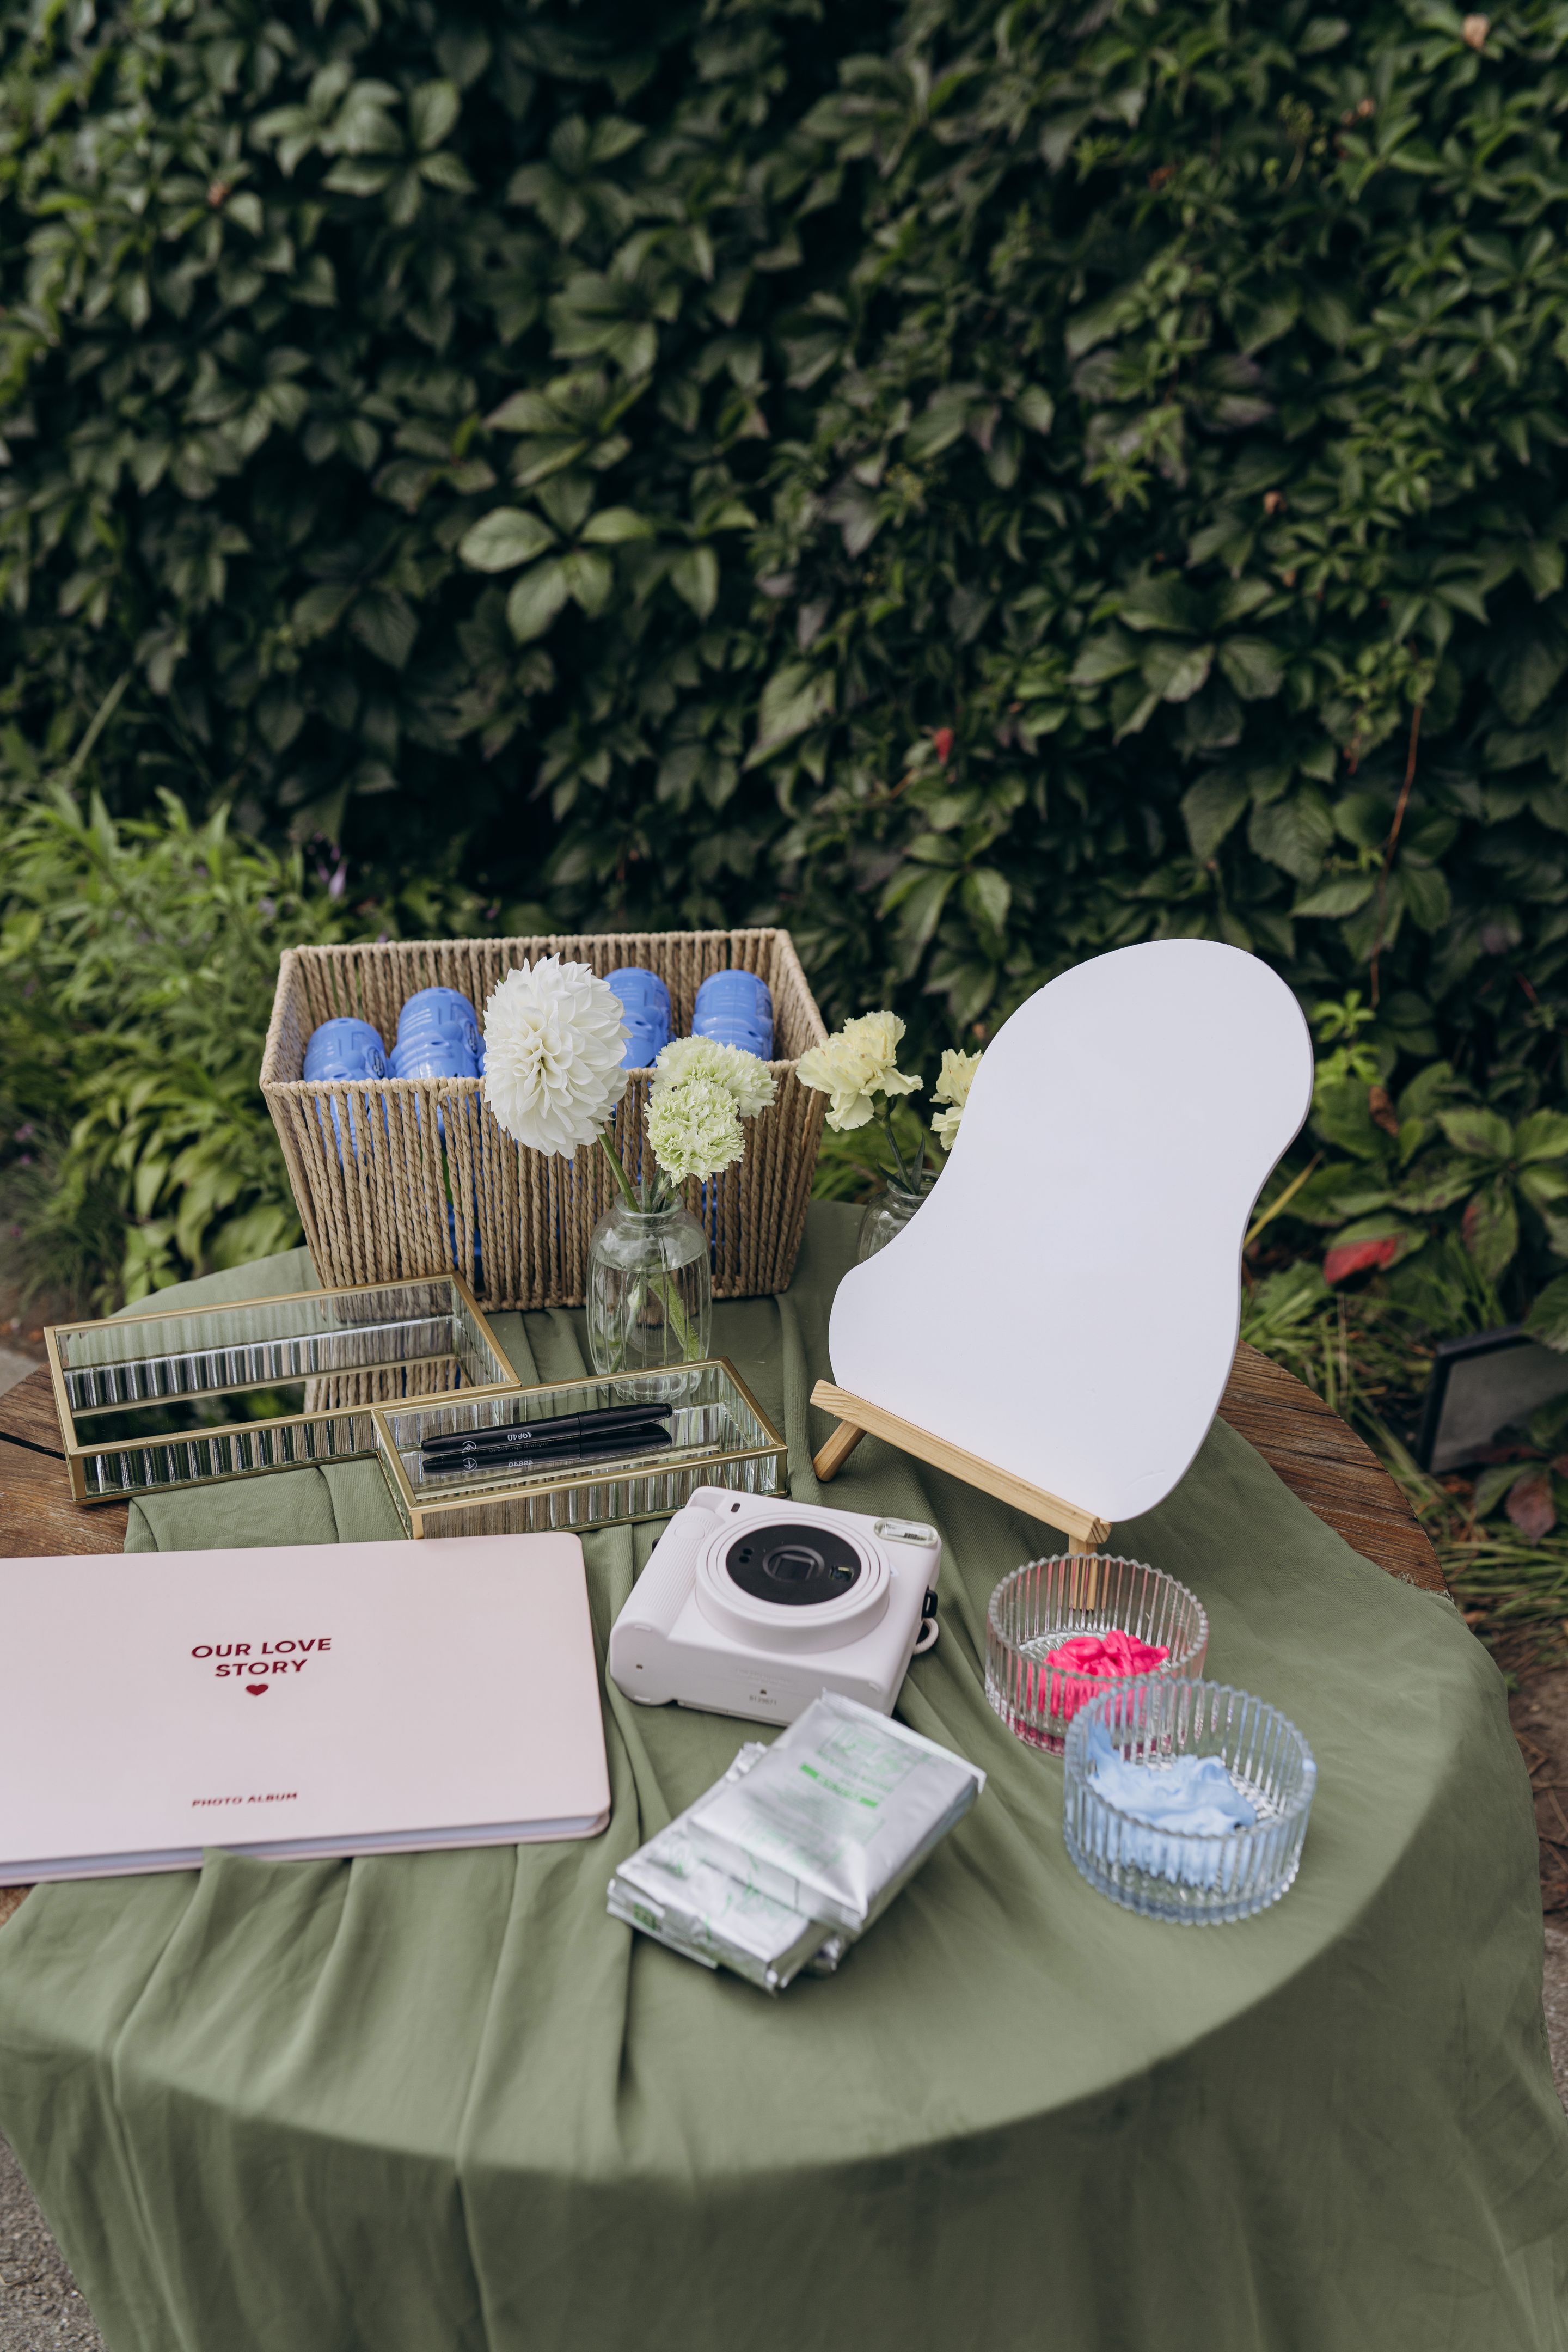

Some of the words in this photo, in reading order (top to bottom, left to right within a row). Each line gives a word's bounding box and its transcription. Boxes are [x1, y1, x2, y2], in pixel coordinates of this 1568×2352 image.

[191, 1643, 251, 1658] OUR
[261, 1638, 332, 1655] LOVE
[215, 1659, 308, 1677] STORY
[192, 1797, 243, 1808] PHOTO
[247, 1791, 298, 1803] ALBUM
